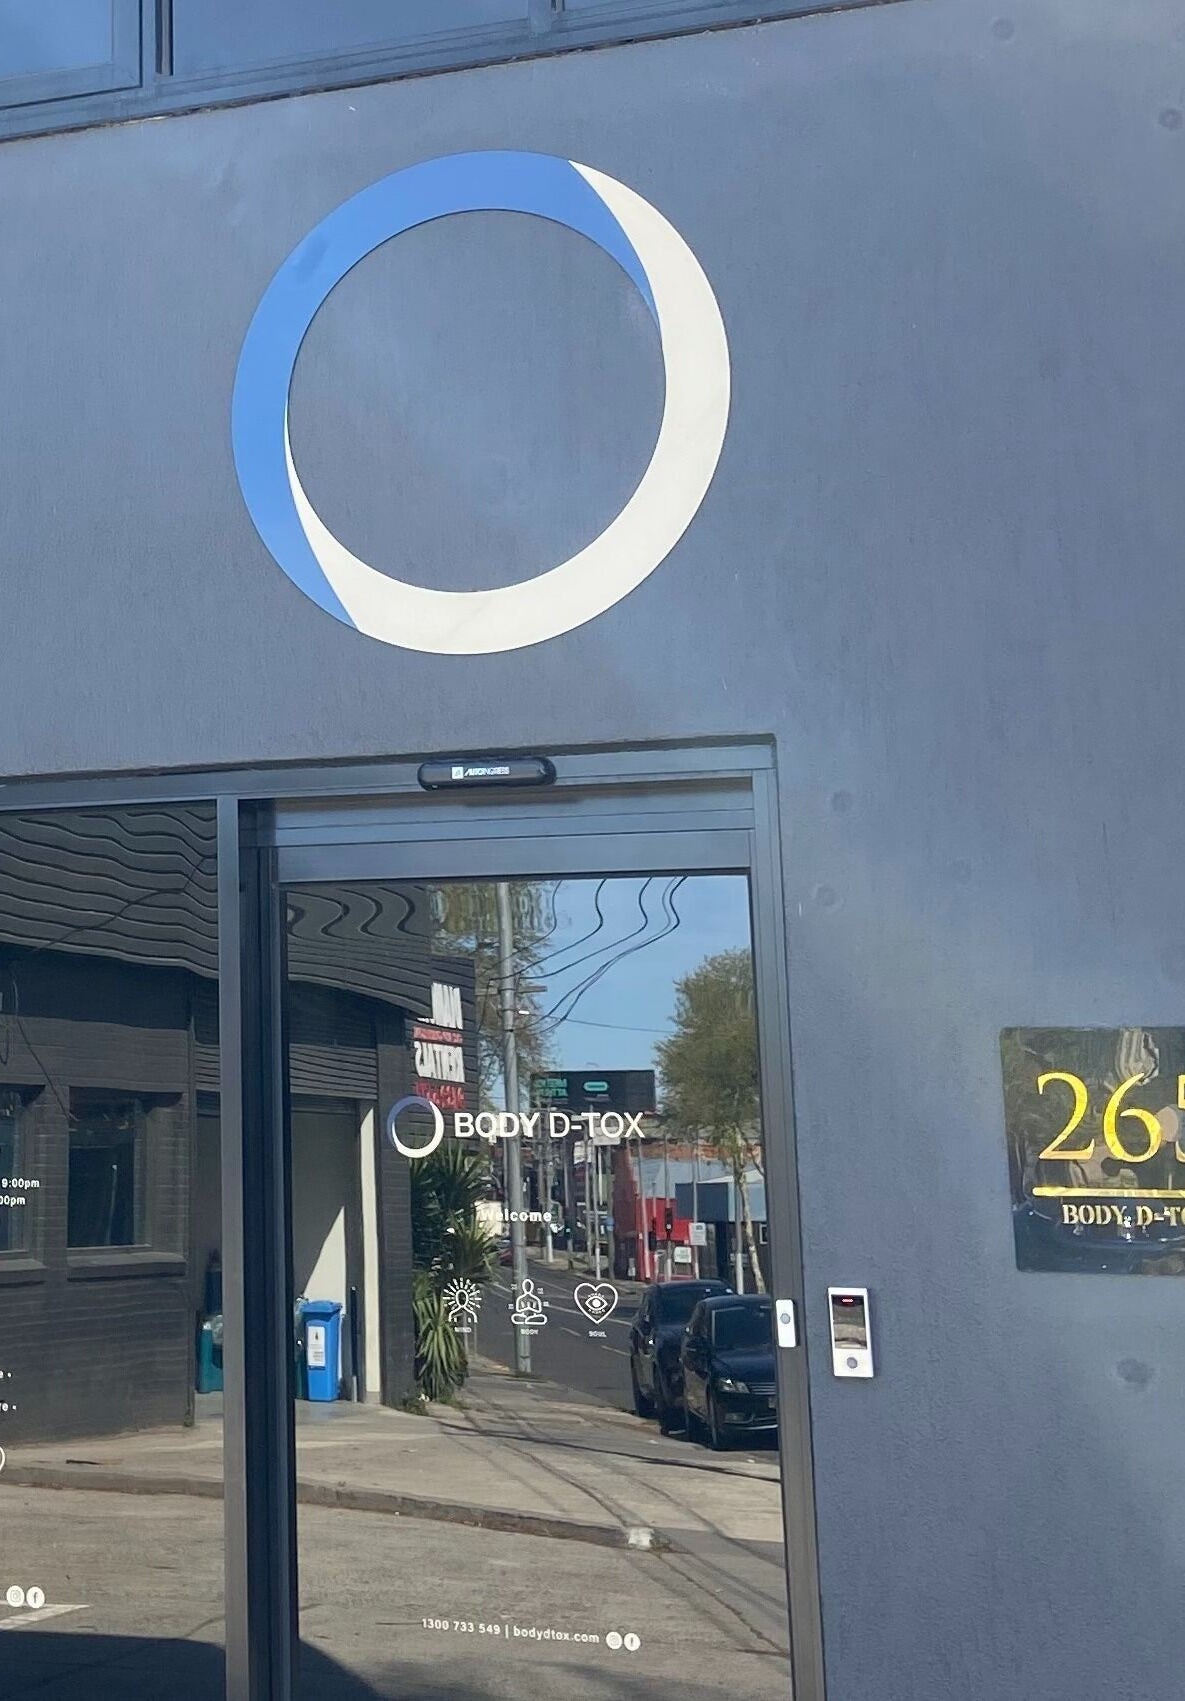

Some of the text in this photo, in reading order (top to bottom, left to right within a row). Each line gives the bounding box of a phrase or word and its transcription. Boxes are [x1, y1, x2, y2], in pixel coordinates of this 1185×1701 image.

[454, 1112, 645, 1139] BODY D-TOX
[1037, 1072, 1185, 1164] 26
[1, 1179, 39, 1189] 9:00pm
[482, 1208, 552, 1222] Welcome
[1063, 1204, 1185, 1227] BODY D-T
[422, 1618, 449, 1630] 1300
[453, 1620, 474, 1633] 733
[479, 1623, 500, 1635] 549
[513, 1626, 599, 1643] bodydtox.com
